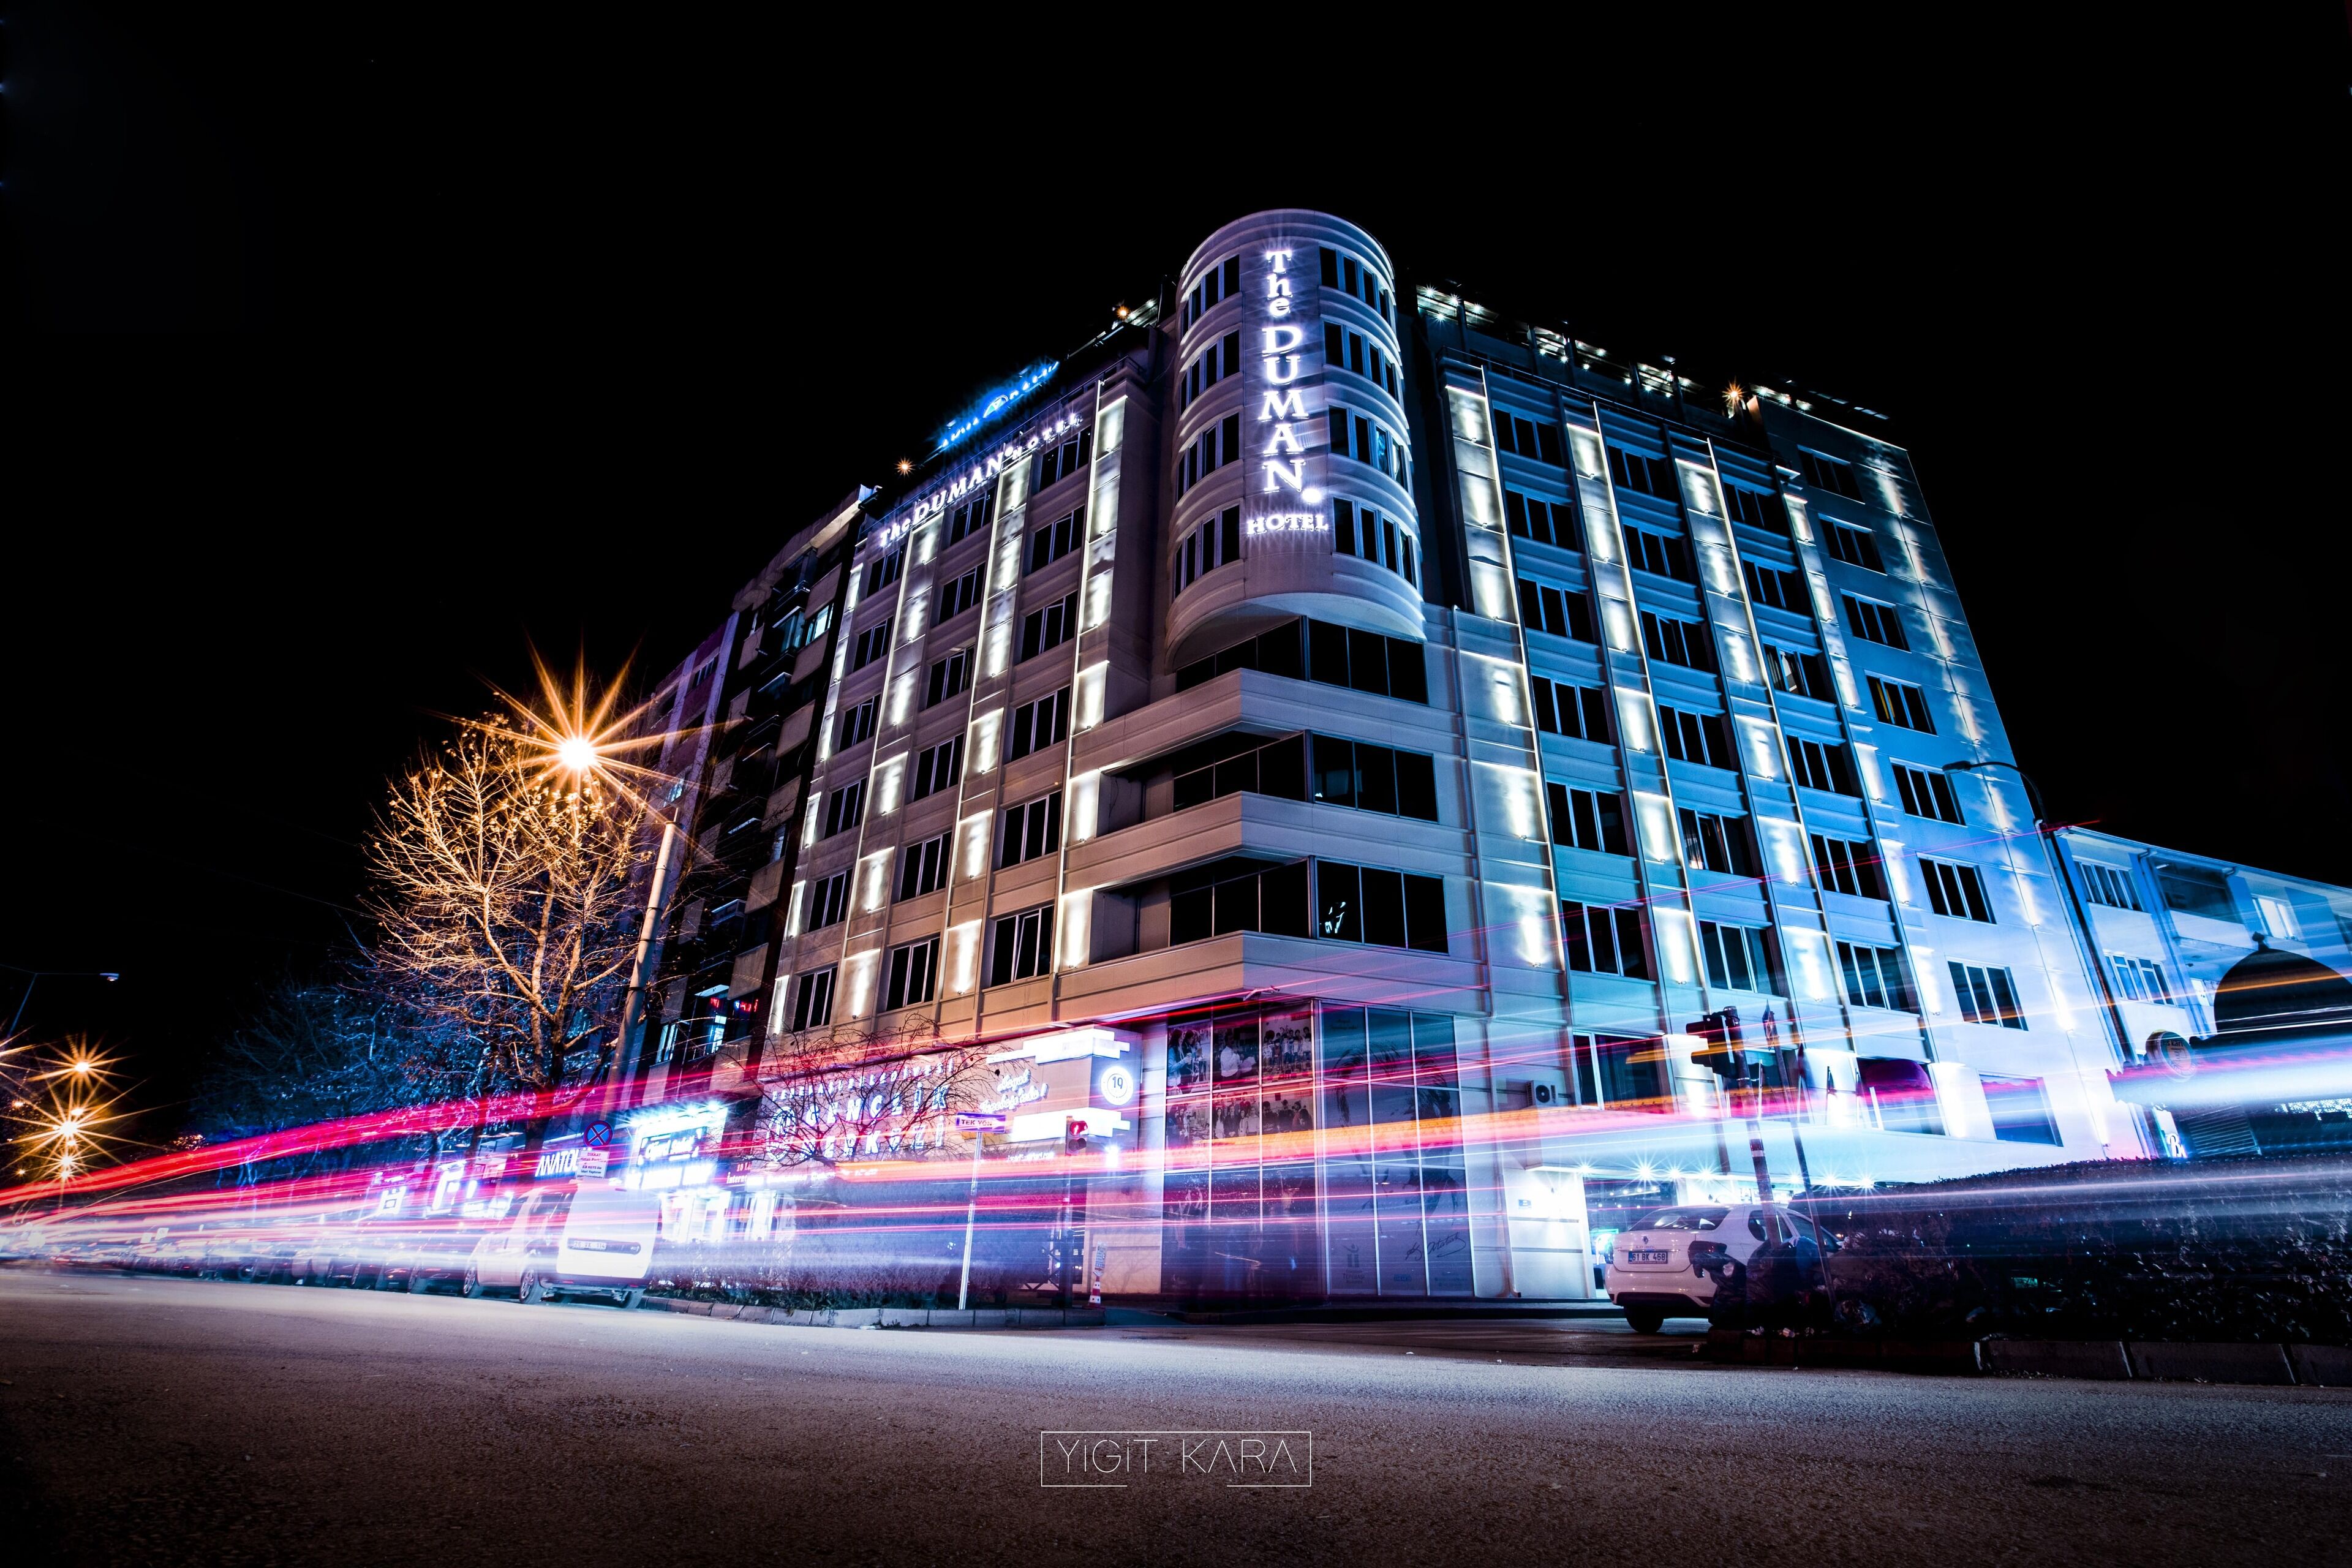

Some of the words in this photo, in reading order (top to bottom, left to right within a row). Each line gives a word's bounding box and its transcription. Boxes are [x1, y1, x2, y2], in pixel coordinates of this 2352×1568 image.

[1266, 249, 1292, 318] The
[1258, 325, 1310, 492] DUMAN
[880, 518, 912, 546] The
[913, 452, 1004, 525] DUMAN
[1012, 413, 1082, 459] HOTEL
[1246, 513, 1329, 536] HOTEL
[1112, 1076, 1123, 1089] 19
